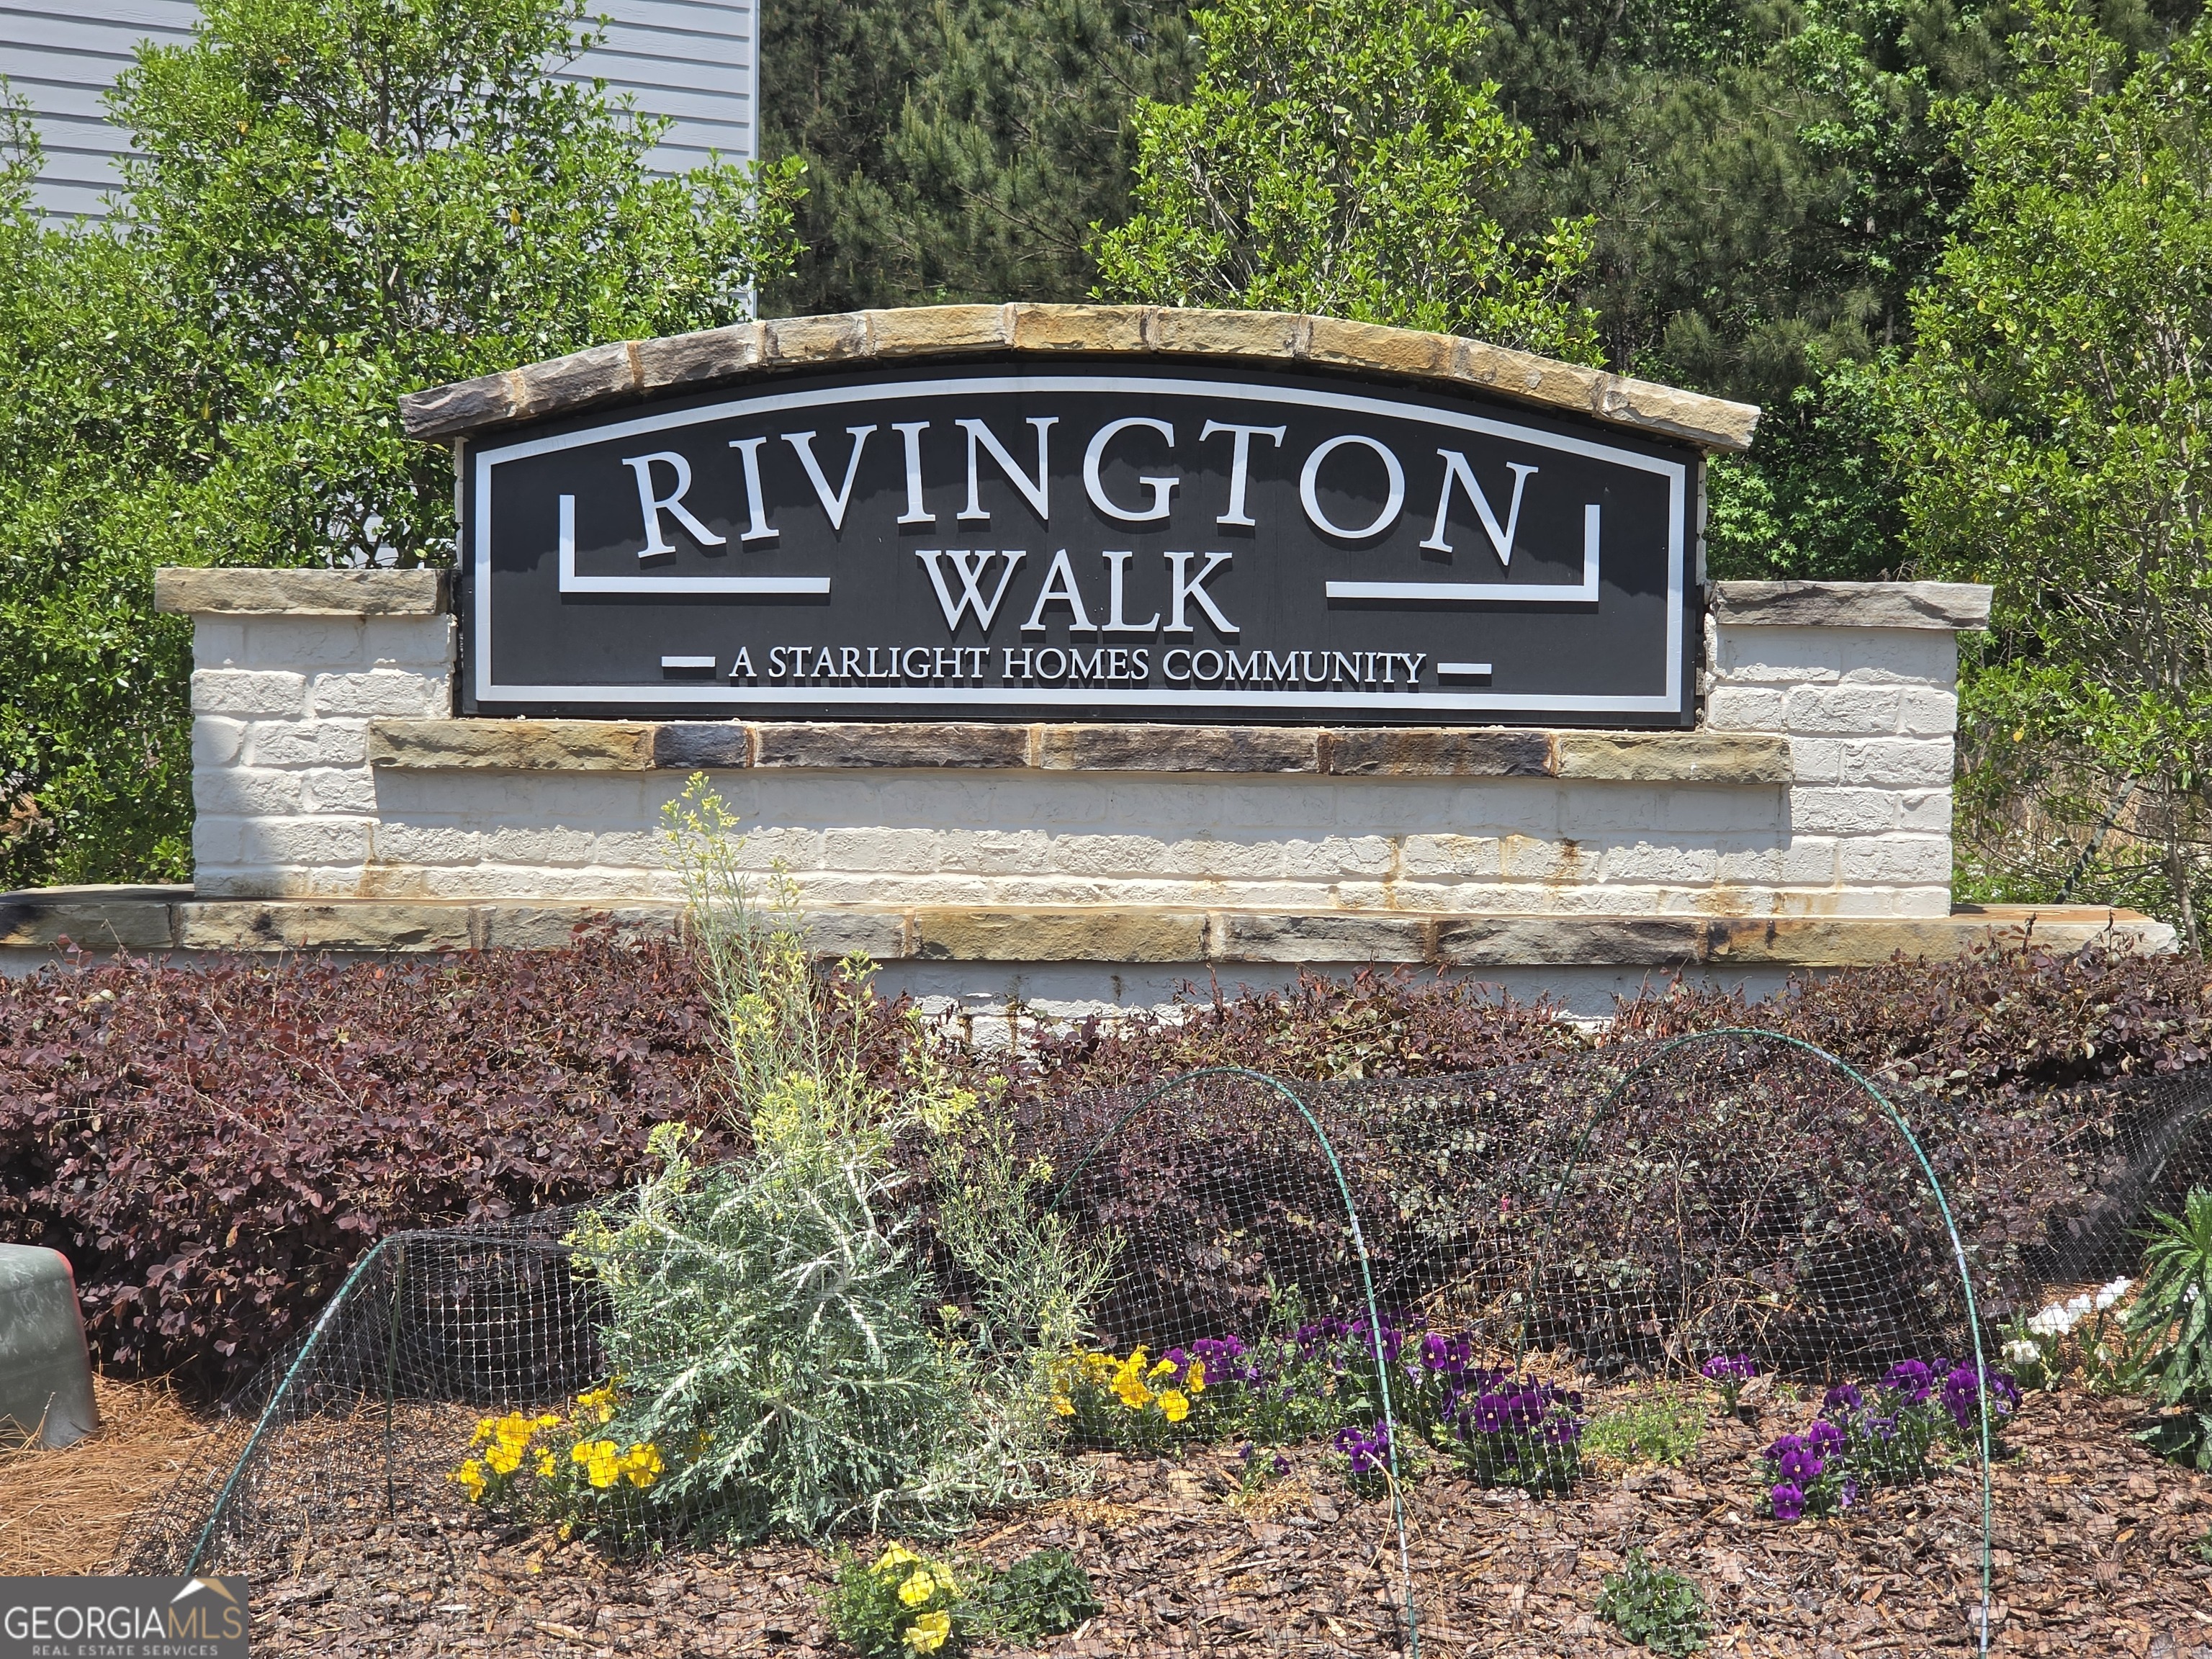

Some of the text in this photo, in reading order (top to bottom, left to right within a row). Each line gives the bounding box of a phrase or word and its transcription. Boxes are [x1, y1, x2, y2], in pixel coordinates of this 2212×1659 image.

[622, 416, 1539, 567] RIVINGTON
[915, 549, 1240, 634] WALK
[729, 646, 1427, 684] A STARLIGHT HOMES COMMUNITY
